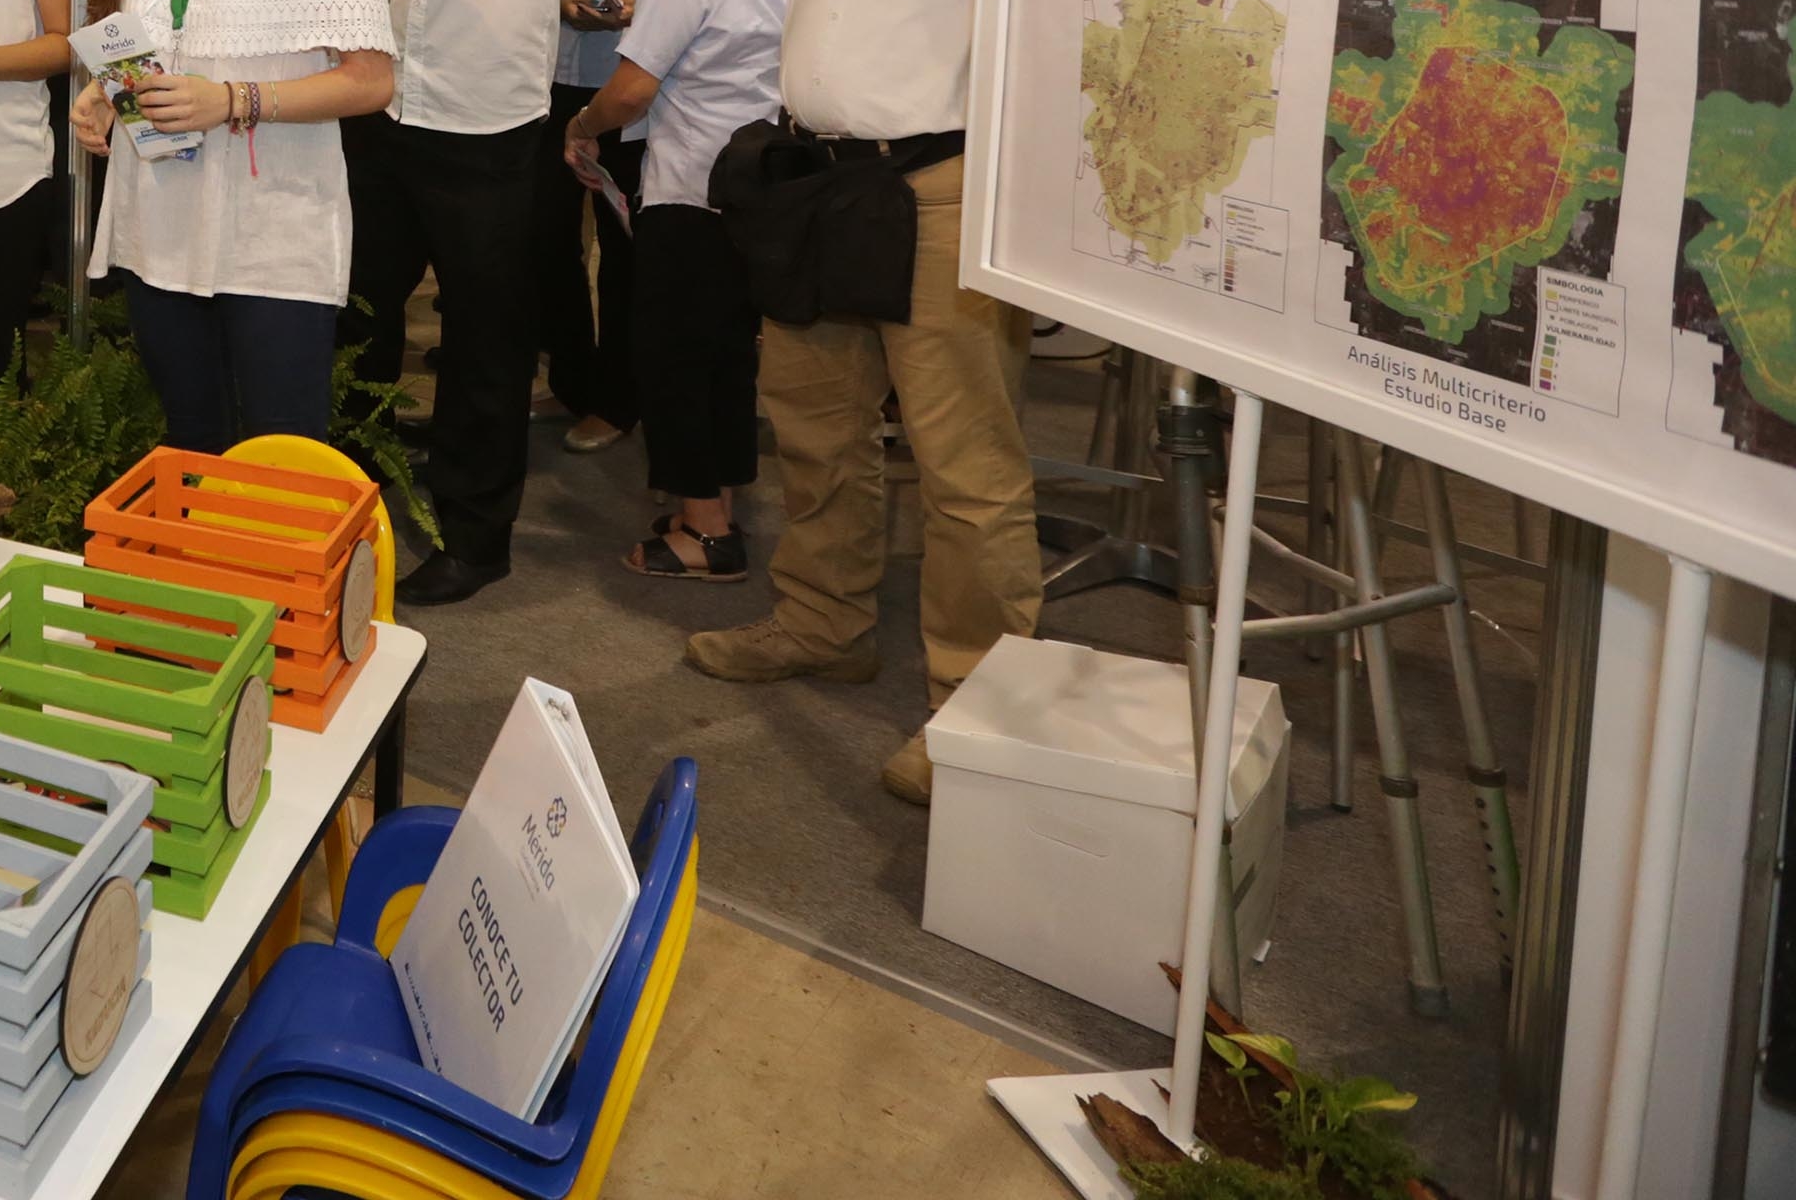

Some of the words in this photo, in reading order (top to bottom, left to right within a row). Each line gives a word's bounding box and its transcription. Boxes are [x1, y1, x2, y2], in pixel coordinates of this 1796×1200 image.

[101, 37, 135, 53] Mérida
[1546, 276, 1604, 297] SIMBOLOGIA
[1546, 325, 1616, 349] VULNERABILIDAD
[1348, 345, 1417, 381] Análisis
[1423, 368, 1546, 422] Multicriterio
[1384, 378, 1452, 415] Estudio
[1458, 402, 1507, 433] Base
[522, 813, 555, 891] Mérida
[458, 908, 505, 1033] COLECTOR
[471, 876, 510, 972] CONOCE
[506, 963, 523, 1006] TU
